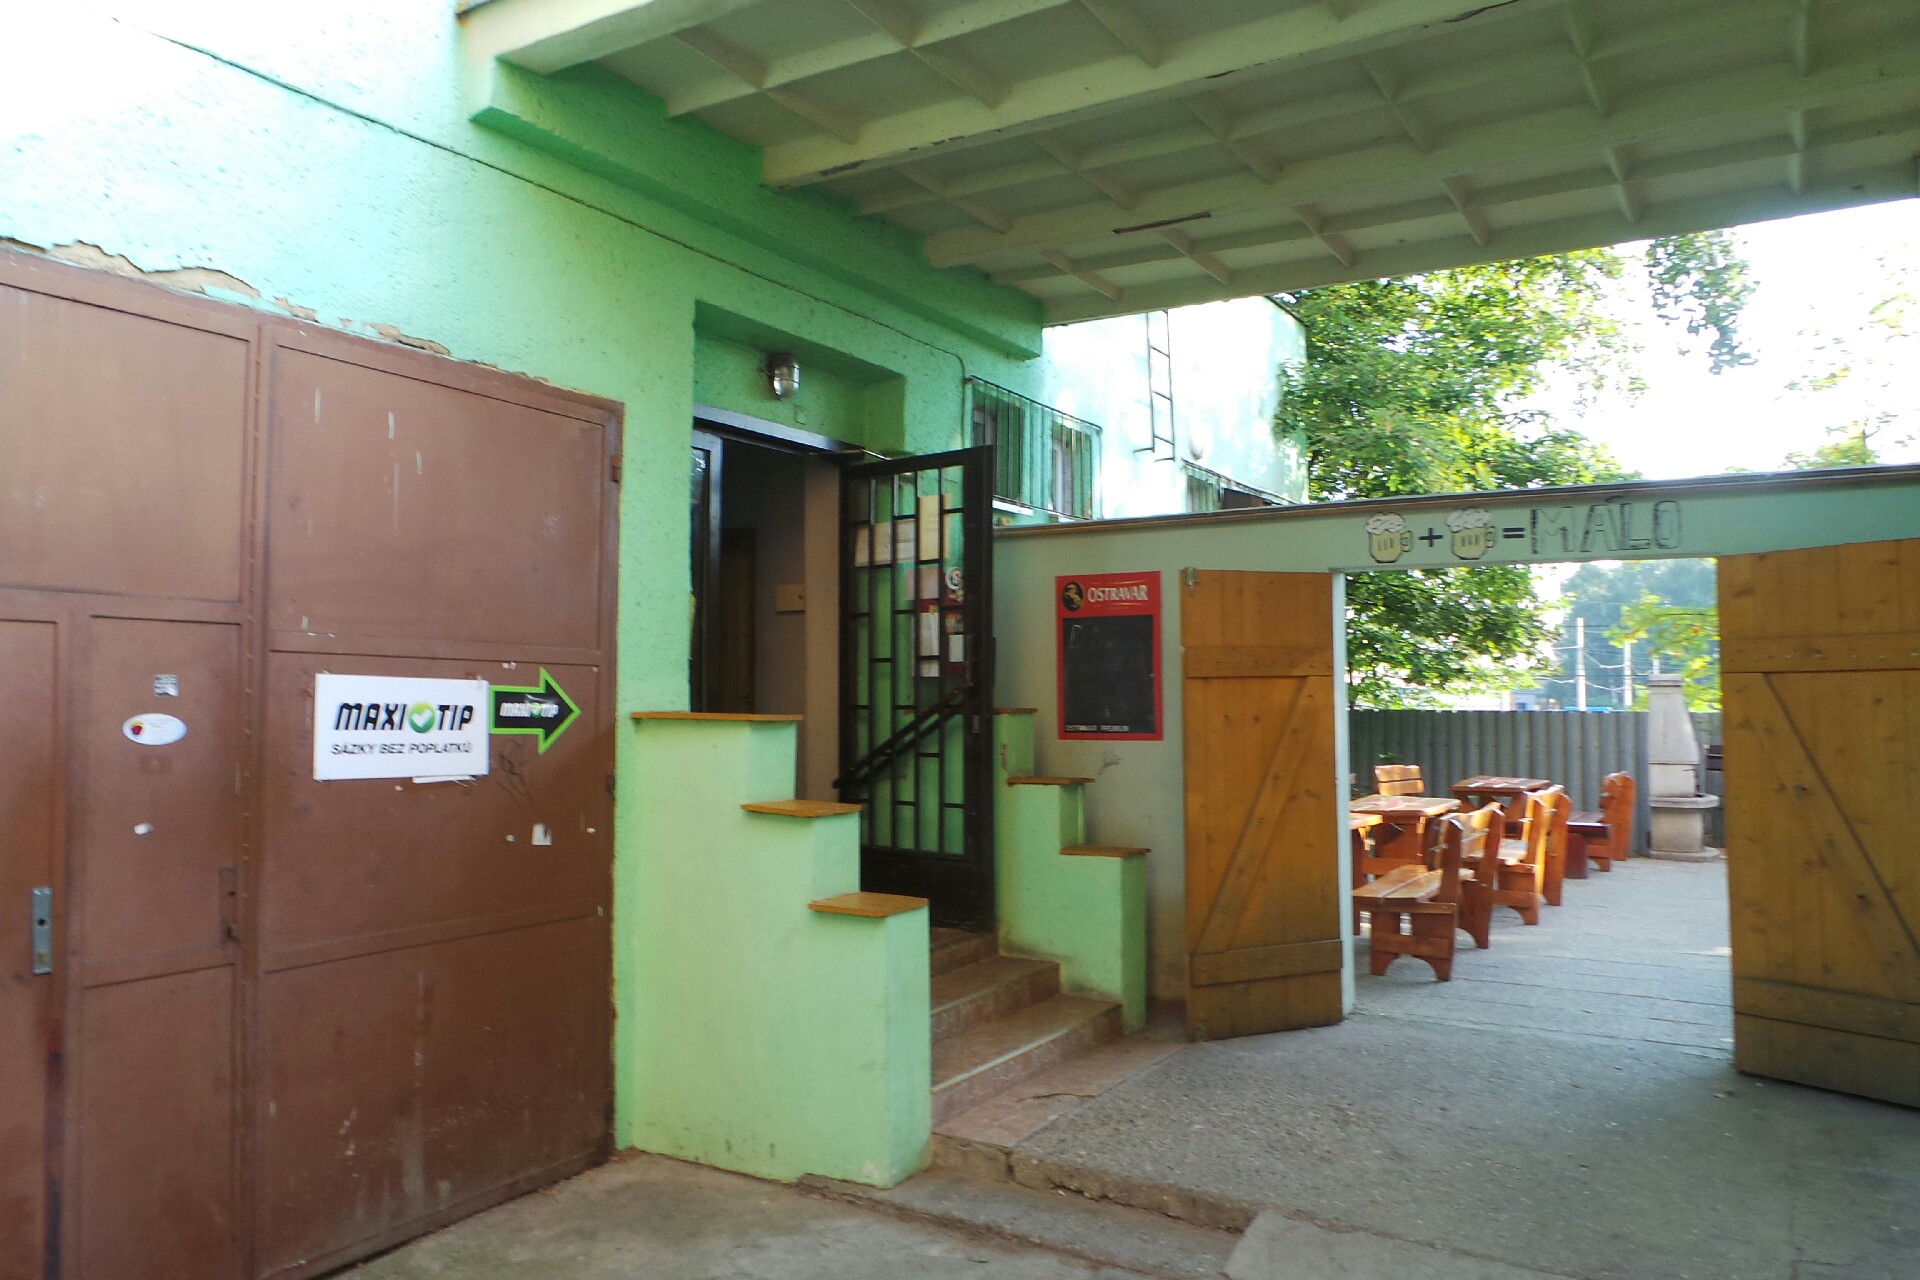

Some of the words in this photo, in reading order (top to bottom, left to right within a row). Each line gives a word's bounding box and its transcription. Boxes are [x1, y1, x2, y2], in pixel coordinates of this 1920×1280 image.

[1087, 584, 1149, 603] OSTRAVAR
[334, 702, 407, 731] MAXI
[436, 704, 474, 731] TIP
[379, 743, 405, 754] BEZ
